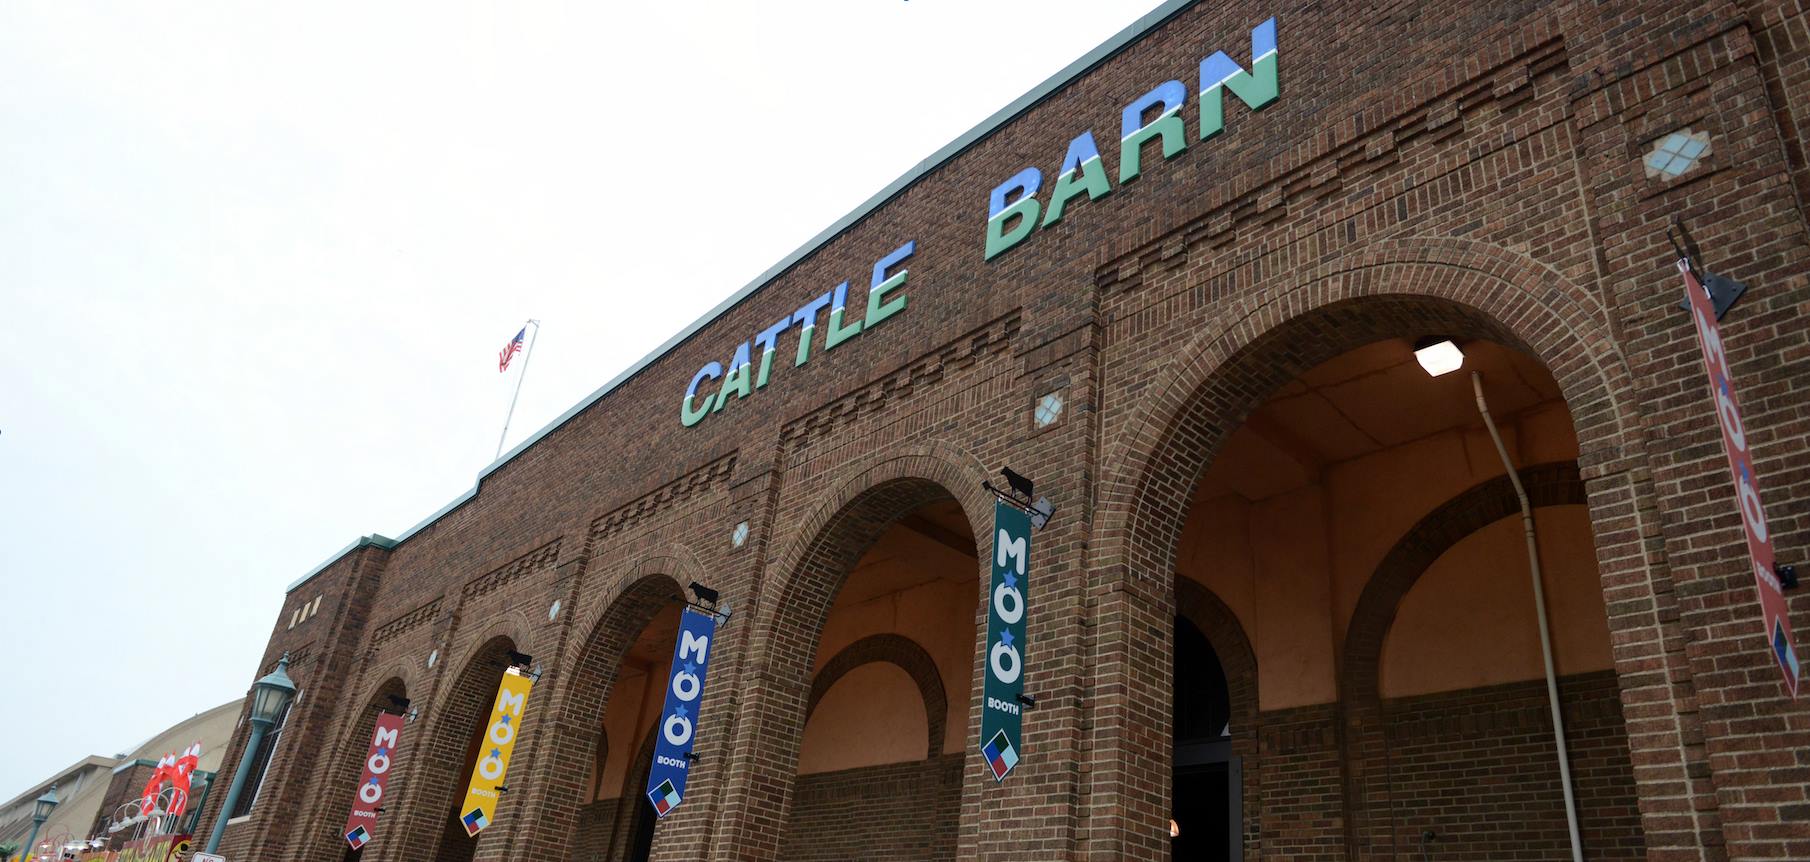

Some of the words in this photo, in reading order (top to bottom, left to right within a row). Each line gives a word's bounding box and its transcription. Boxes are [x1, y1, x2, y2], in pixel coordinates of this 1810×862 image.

[681, 240, 916, 427] CATTLE
[985, 16, 1280, 262] BARN
[1696, 307, 1767, 544] MOO
[990, 528, 1026, 684] MOO
[664, 630, 709, 746] MOO
[987, 697, 1019, 715] BOOTH
[359, 726, 398, 803] MOO
[479, 688, 525, 780] MOO
[657, 755, 686, 769] BOOTH
[353, 809, 377, 819] BOOTH
[471, 787, 497, 798] BOOTH
